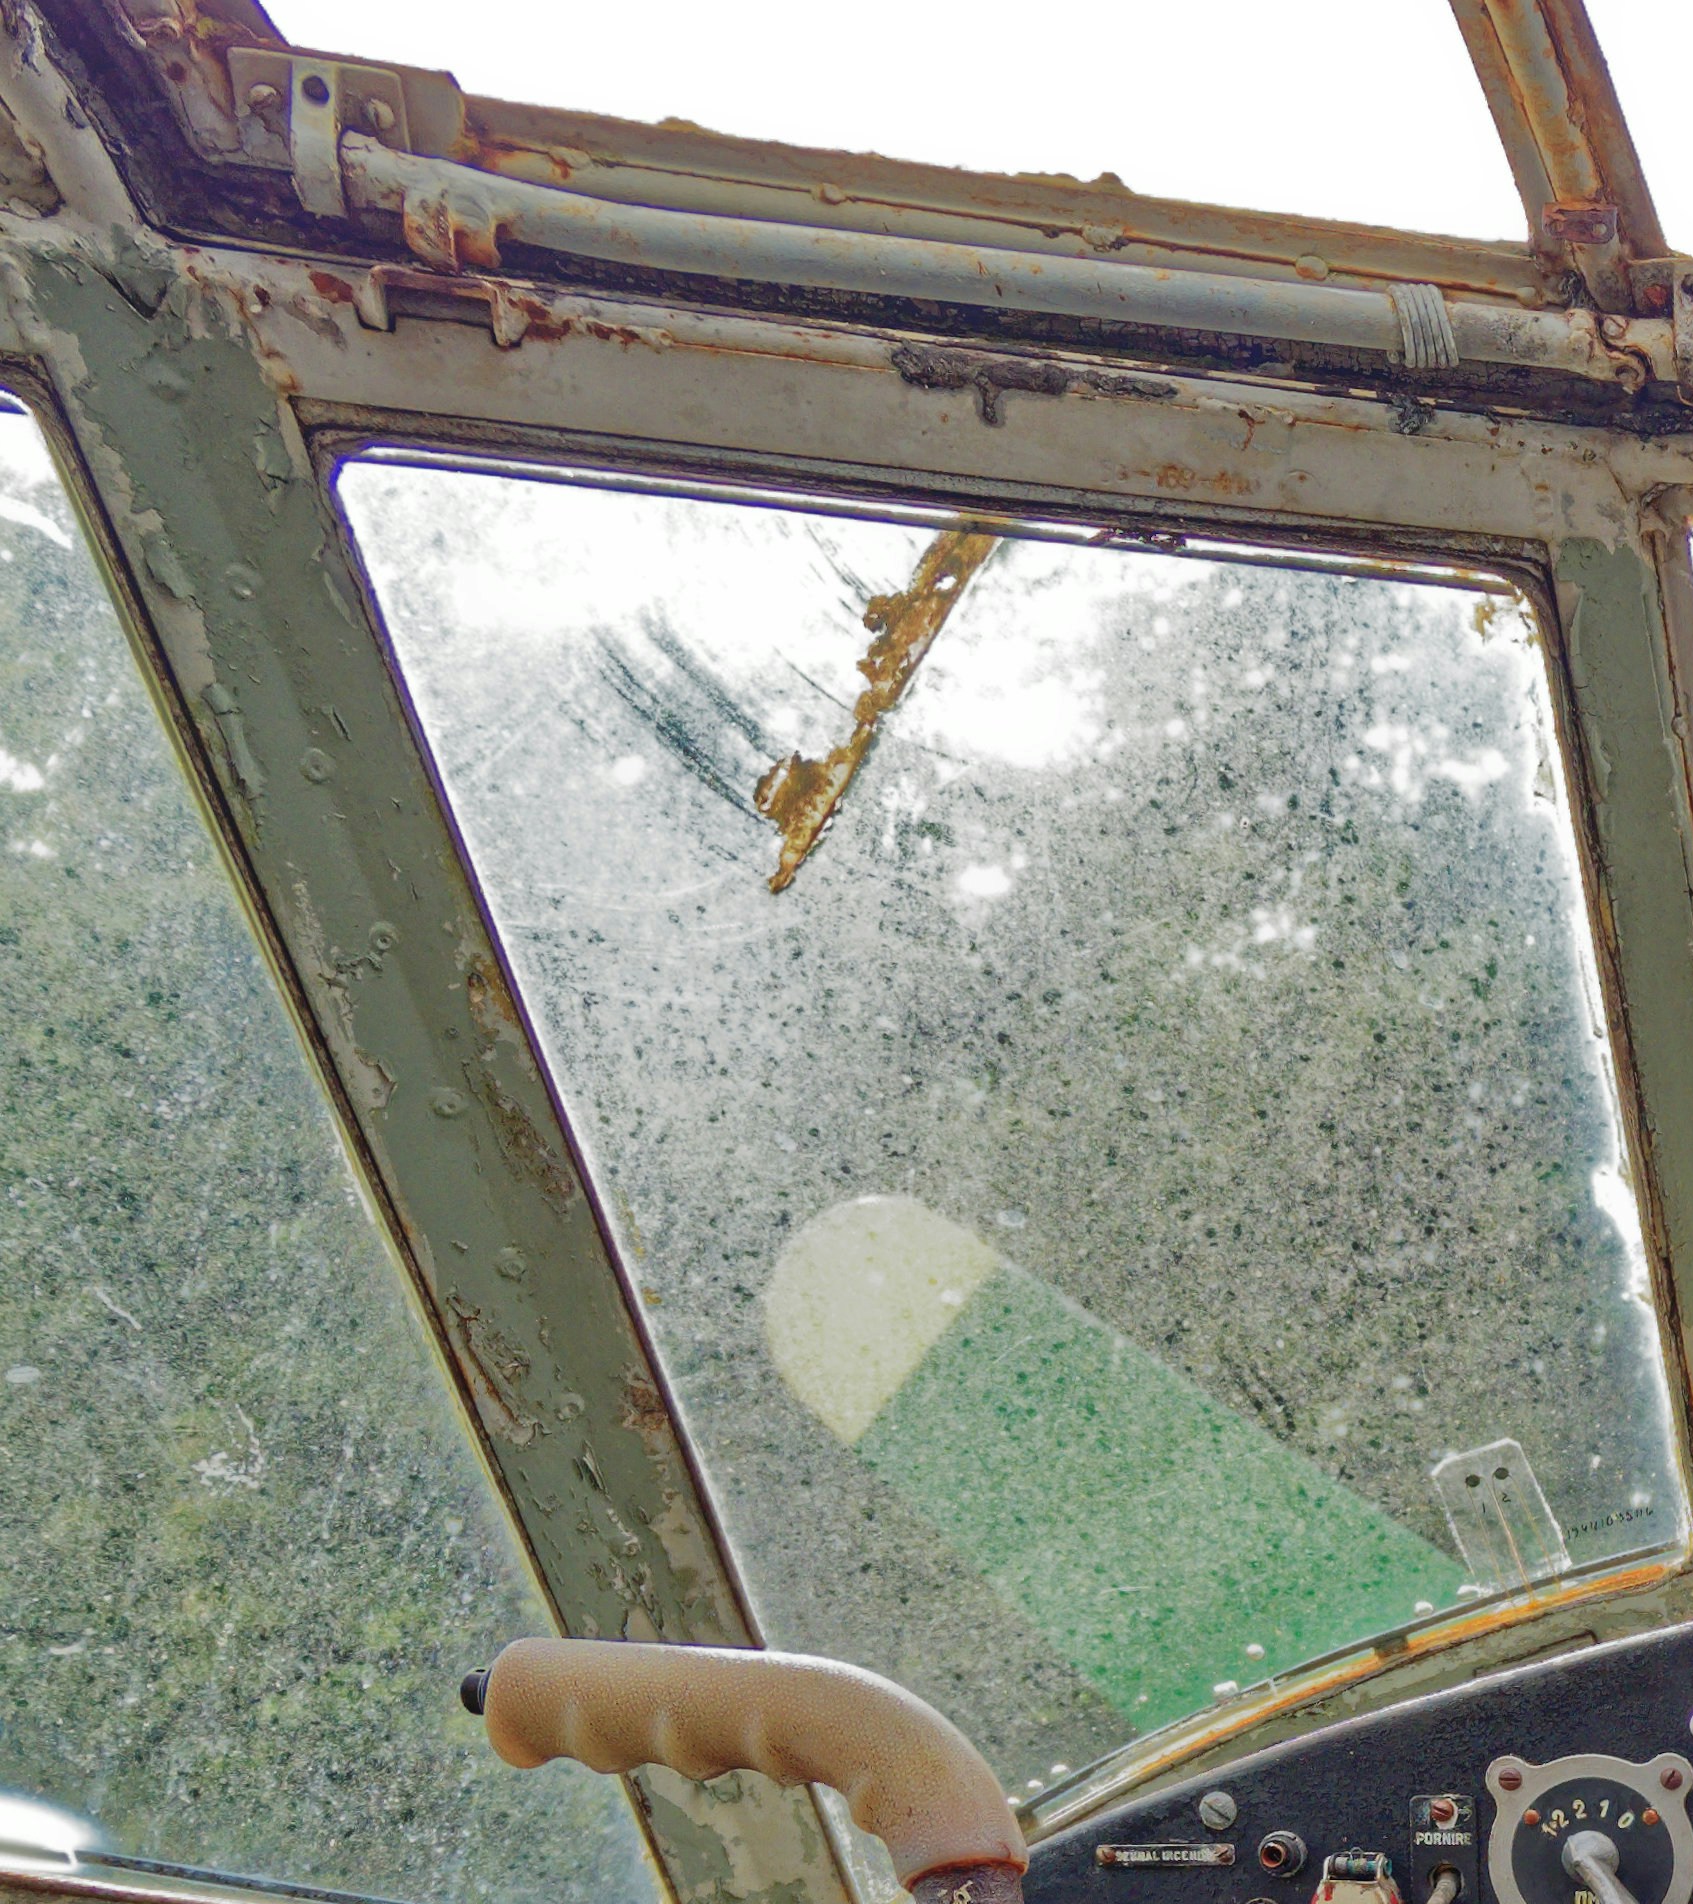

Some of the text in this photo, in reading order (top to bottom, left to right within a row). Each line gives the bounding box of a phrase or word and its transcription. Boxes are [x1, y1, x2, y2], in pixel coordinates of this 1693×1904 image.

[1573, 1799, 1634, 1828] 2 1 0
[1416, 1832, 1471, 1846] PORNIRE
